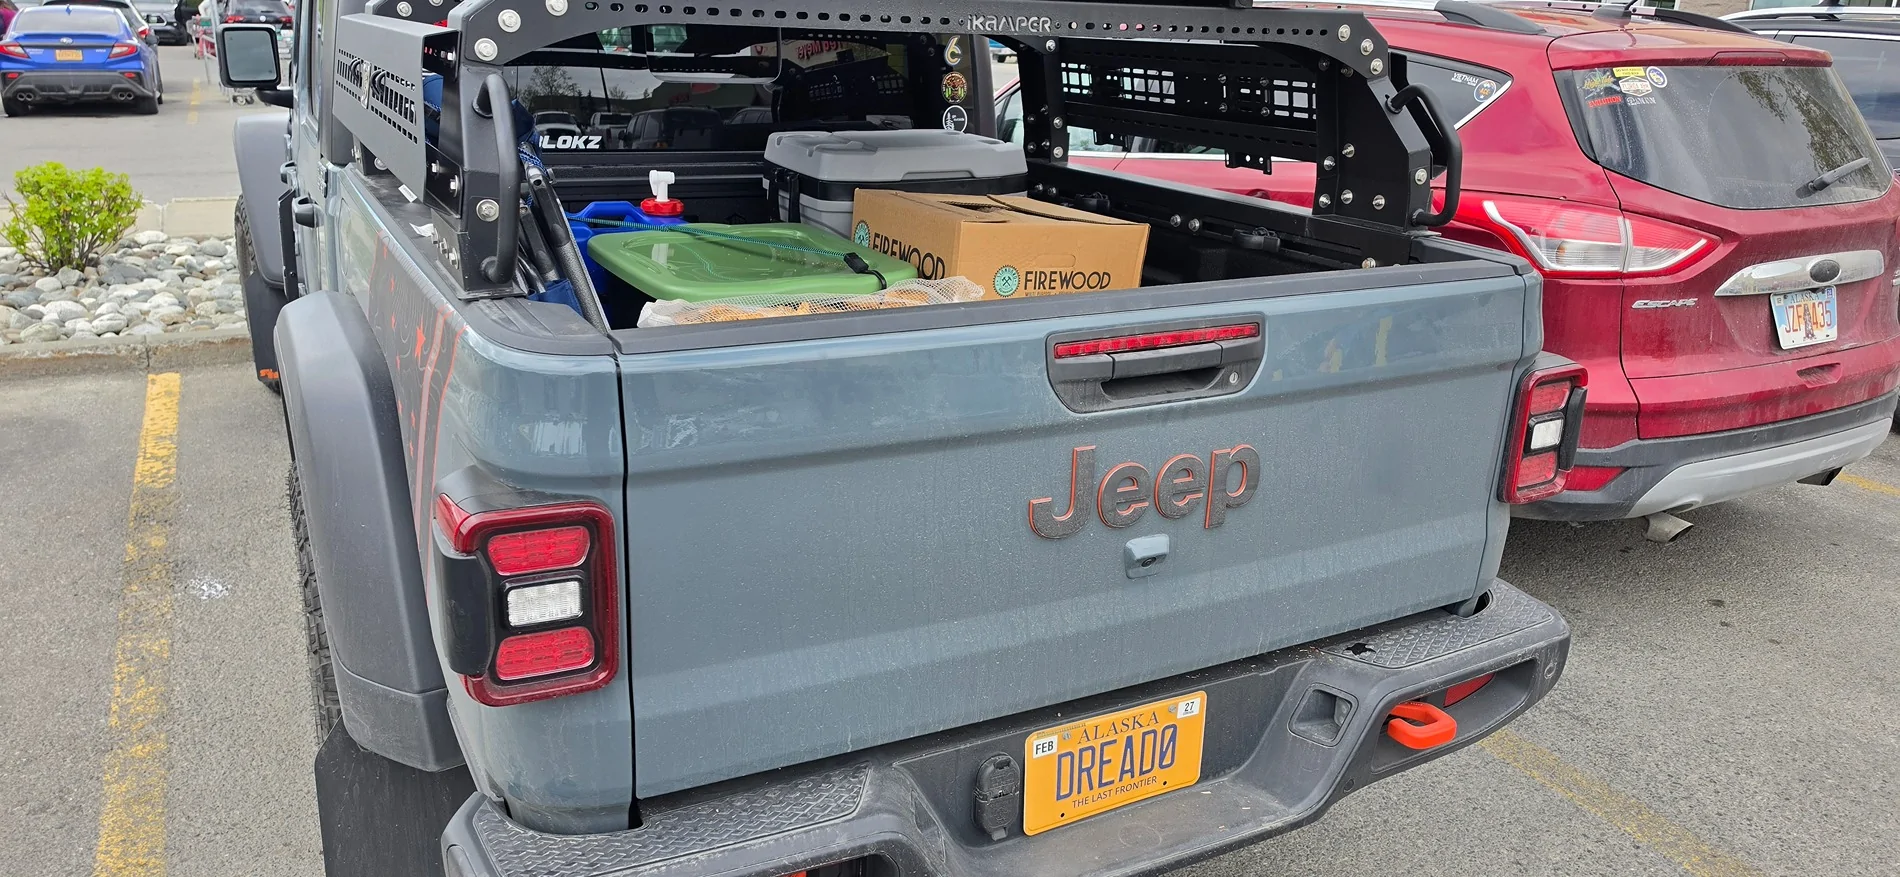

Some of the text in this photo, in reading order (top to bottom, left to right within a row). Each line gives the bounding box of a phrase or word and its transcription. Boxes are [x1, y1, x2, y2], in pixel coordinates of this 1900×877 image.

[1024, 270, 1112, 290] FIREWOOD
[1632, 297, 1699, 309] ESCAPE
[1028, 443, 1261, 539] Jeep
[1184, 701, 1195, 712] 27
[1077, 711, 1160, 745] ALASKA
[1035, 740, 1054, 755] FEB
[1072, 775, 1157, 809] THE LAST FRONTIER
